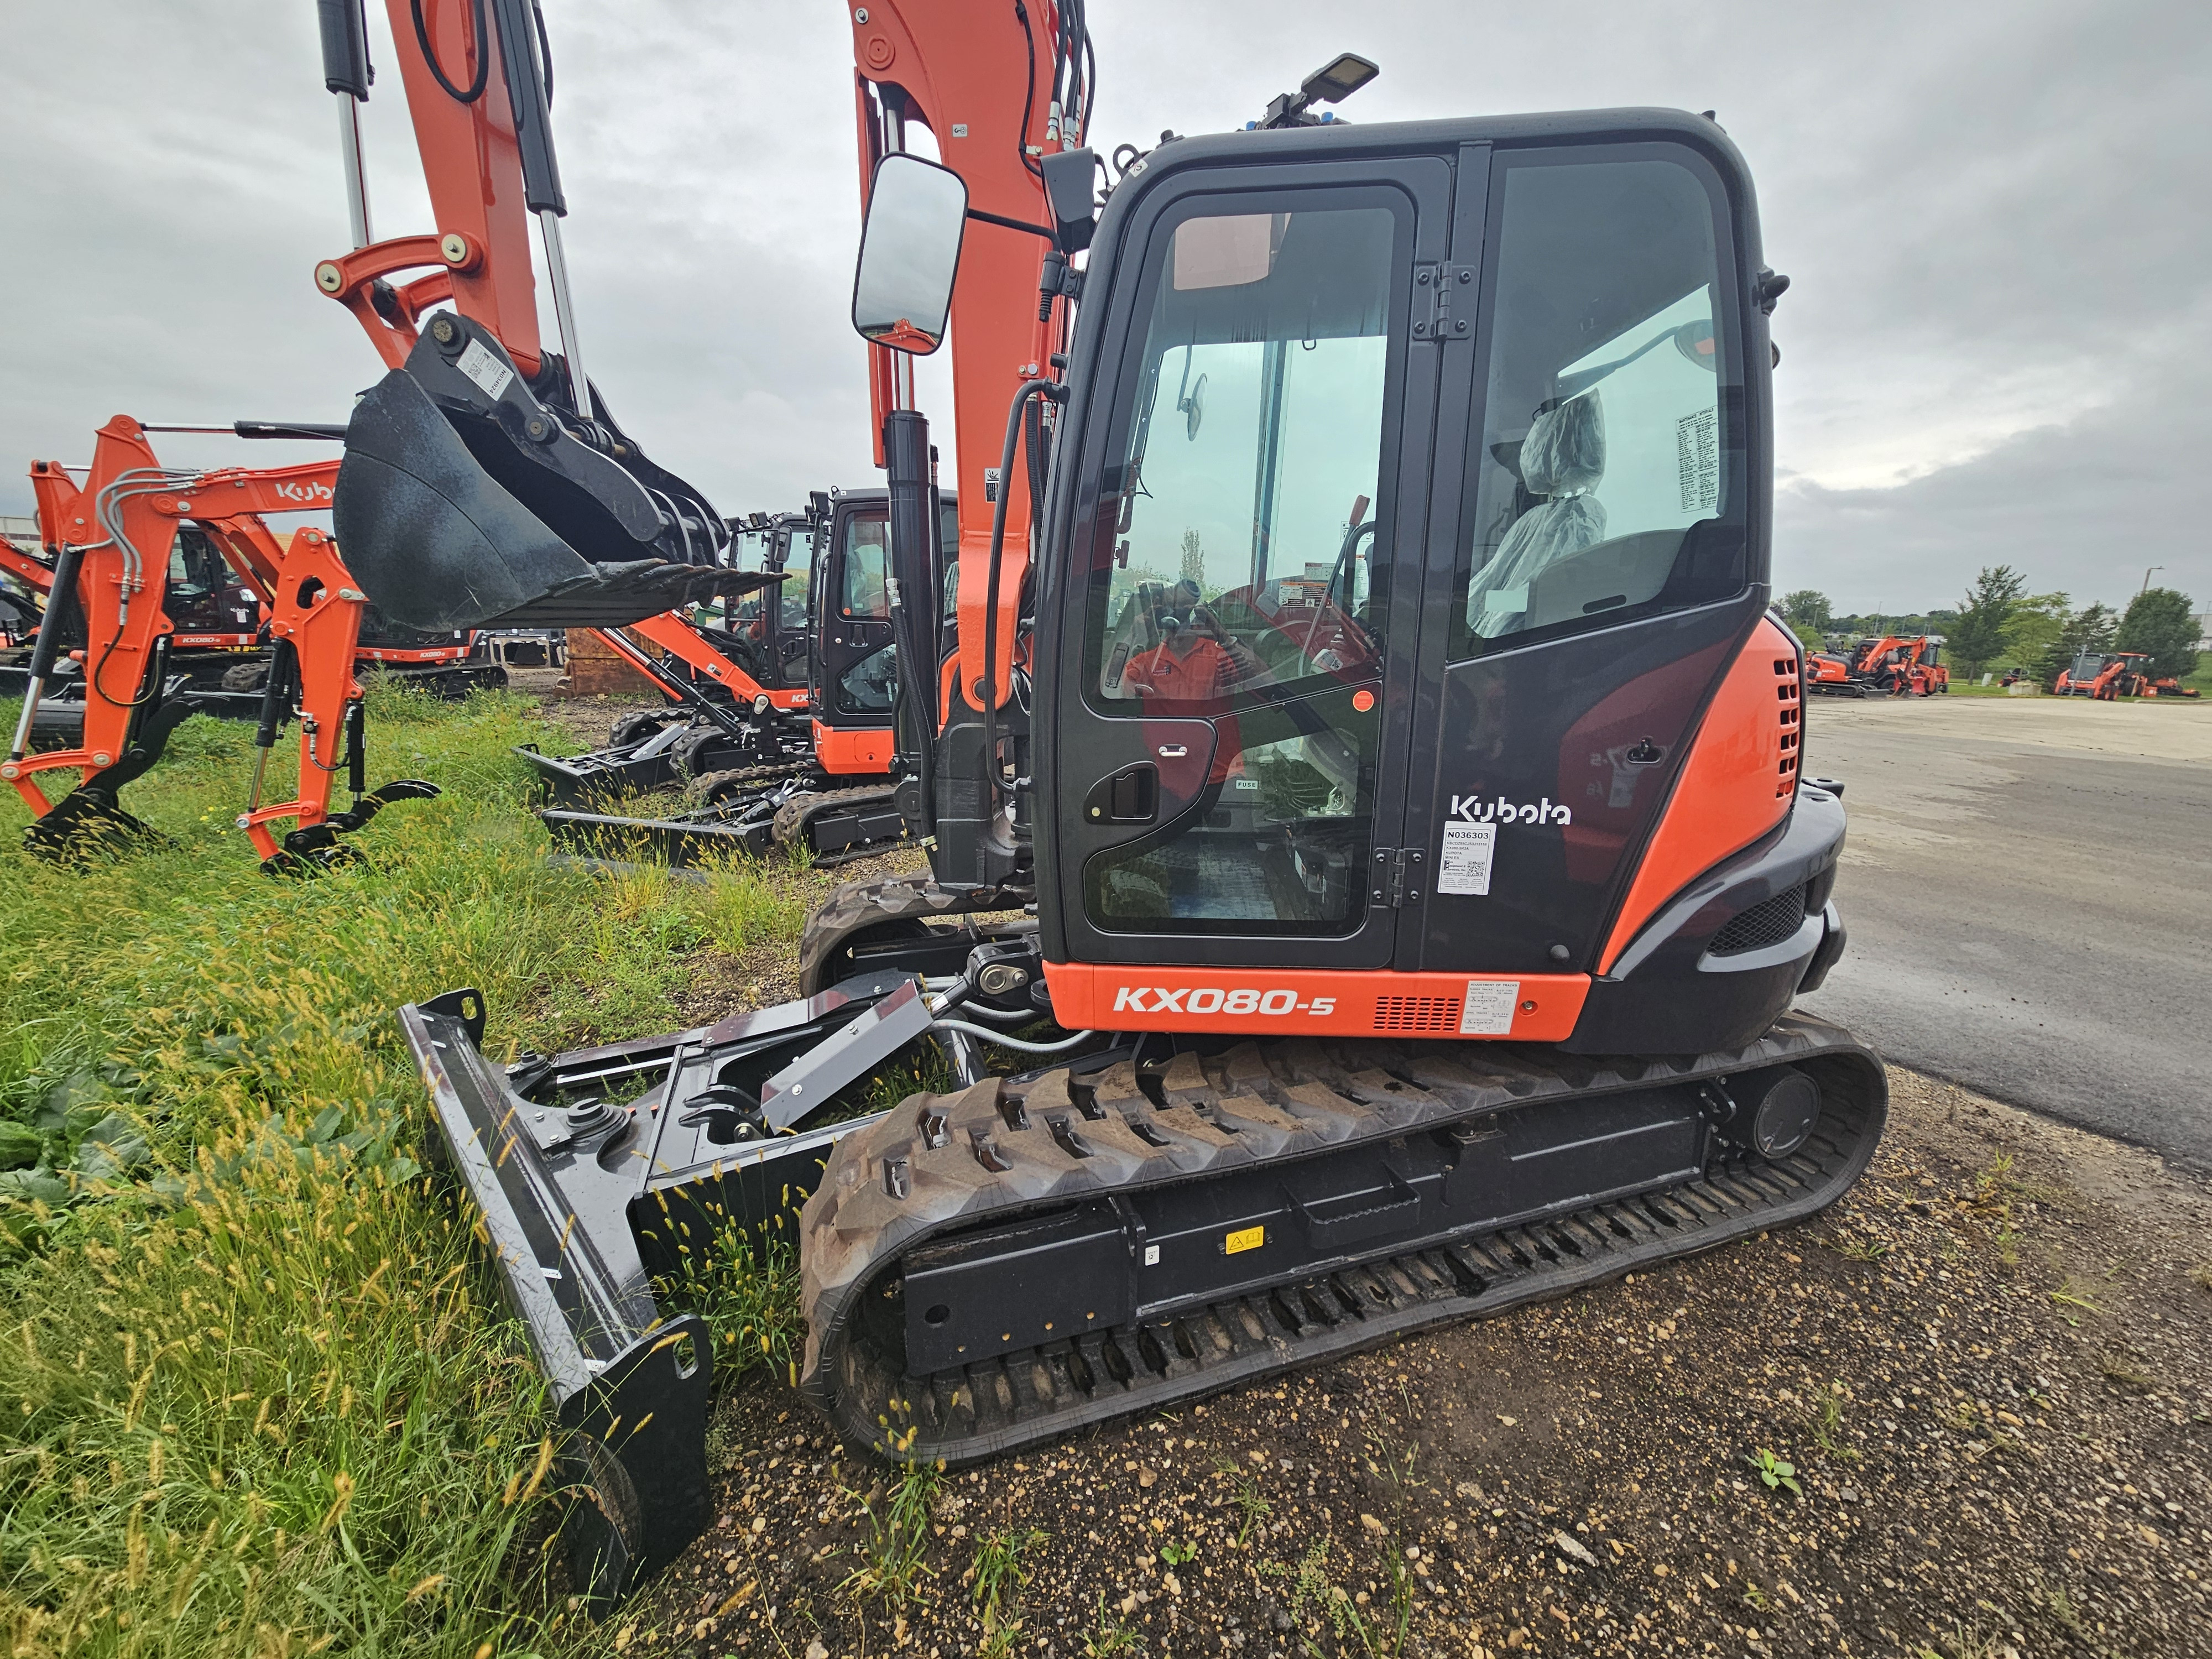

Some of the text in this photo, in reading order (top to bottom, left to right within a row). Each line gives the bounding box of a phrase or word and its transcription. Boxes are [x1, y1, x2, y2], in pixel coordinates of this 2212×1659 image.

[489, 369, 507, 394] N034924
[275, 482, 335, 501] Kub
[791, 694, 809, 702] KX
[1451, 795, 1571, 825] Kubota
[1113, 987, 1337, 1015] KX080-5
